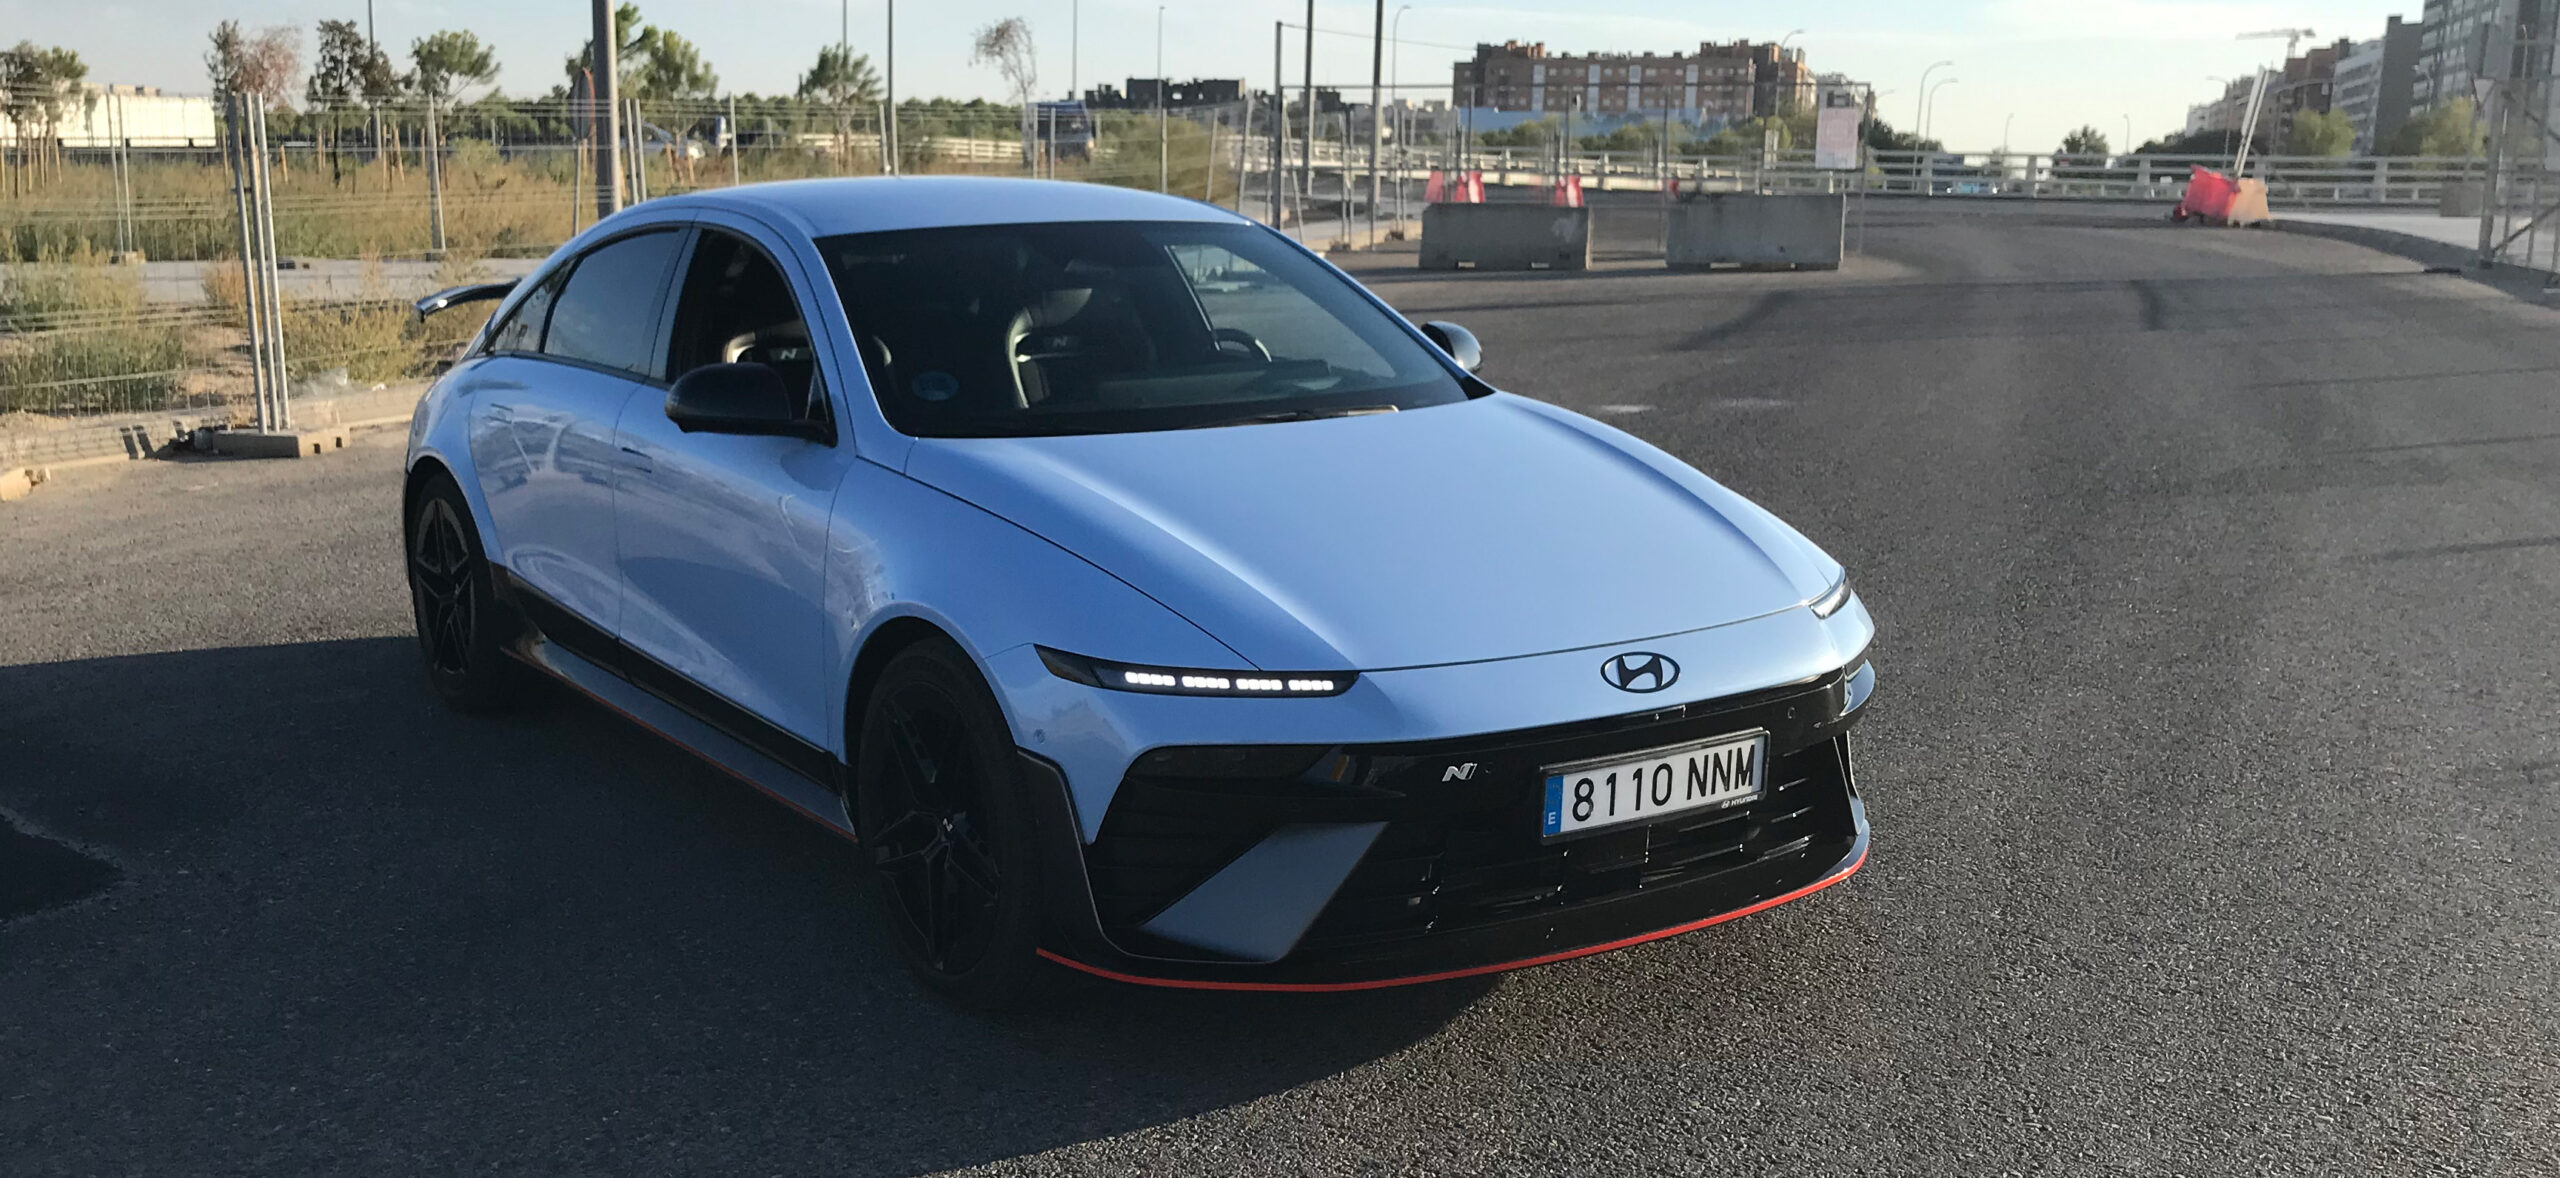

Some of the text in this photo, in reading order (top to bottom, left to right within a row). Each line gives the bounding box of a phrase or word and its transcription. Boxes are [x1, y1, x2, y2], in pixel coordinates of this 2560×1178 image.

[780, 348, 798, 360] N
[1547, 744, 1756, 825] E 8110 NNM
